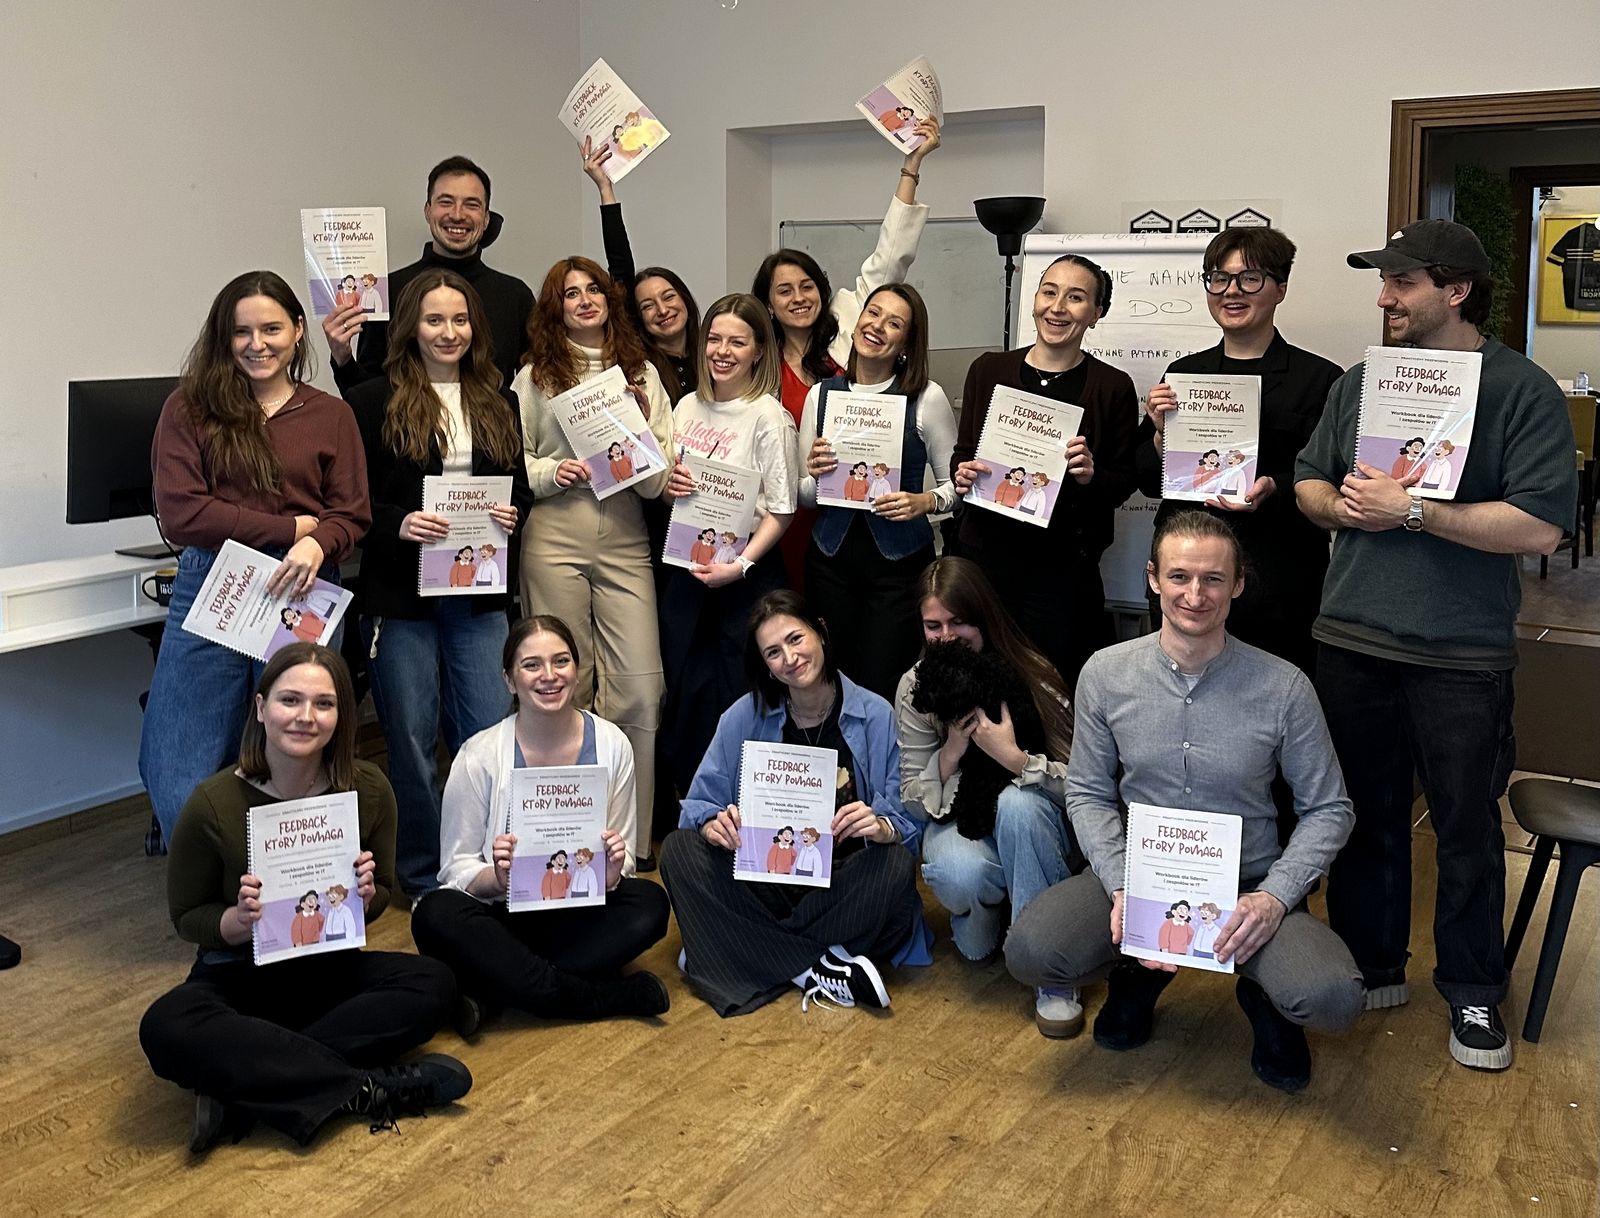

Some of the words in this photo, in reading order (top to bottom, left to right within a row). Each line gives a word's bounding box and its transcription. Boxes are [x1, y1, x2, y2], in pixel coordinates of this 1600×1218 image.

[572, 82, 597, 113] FEEDBACK
[324, 220, 362, 232] FEEDBACK
[1396, 366, 1448, 382] FEEDBACK
[1188, 388, 1232, 400] FEEDBACK
[1416, 382, 1461, 397] POMAGA
[573, 388, 607, 412] FEEDBACK
[1208, 402, 1245, 413] POMAGA
[845, 405, 882, 417] FEEDBACK
[1012, 405, 1054, 424] FEEDBACK
[1026, 423, 1062, 440] POMAGA
[700, 471, 737, 489] FEEDBACK
[448, 490, 488, 500] FEEDBACK
[210, 571, 238, 615] FEEDBACK
[768, 759, 810, 774] FEEDBACK
[785, 774, 822, 788] POMAGA
[536, 784, 580, 797] FEEDBACK
[555, 796, 592, 810] POMAGA
[279, 814, 328, 836] FEEDBACK
[301, 828, 344, 846] POMAGA
[1158, 825, 1208, 843] FEEDBACK
[1178, 842, 1222, 860] POMAGA
